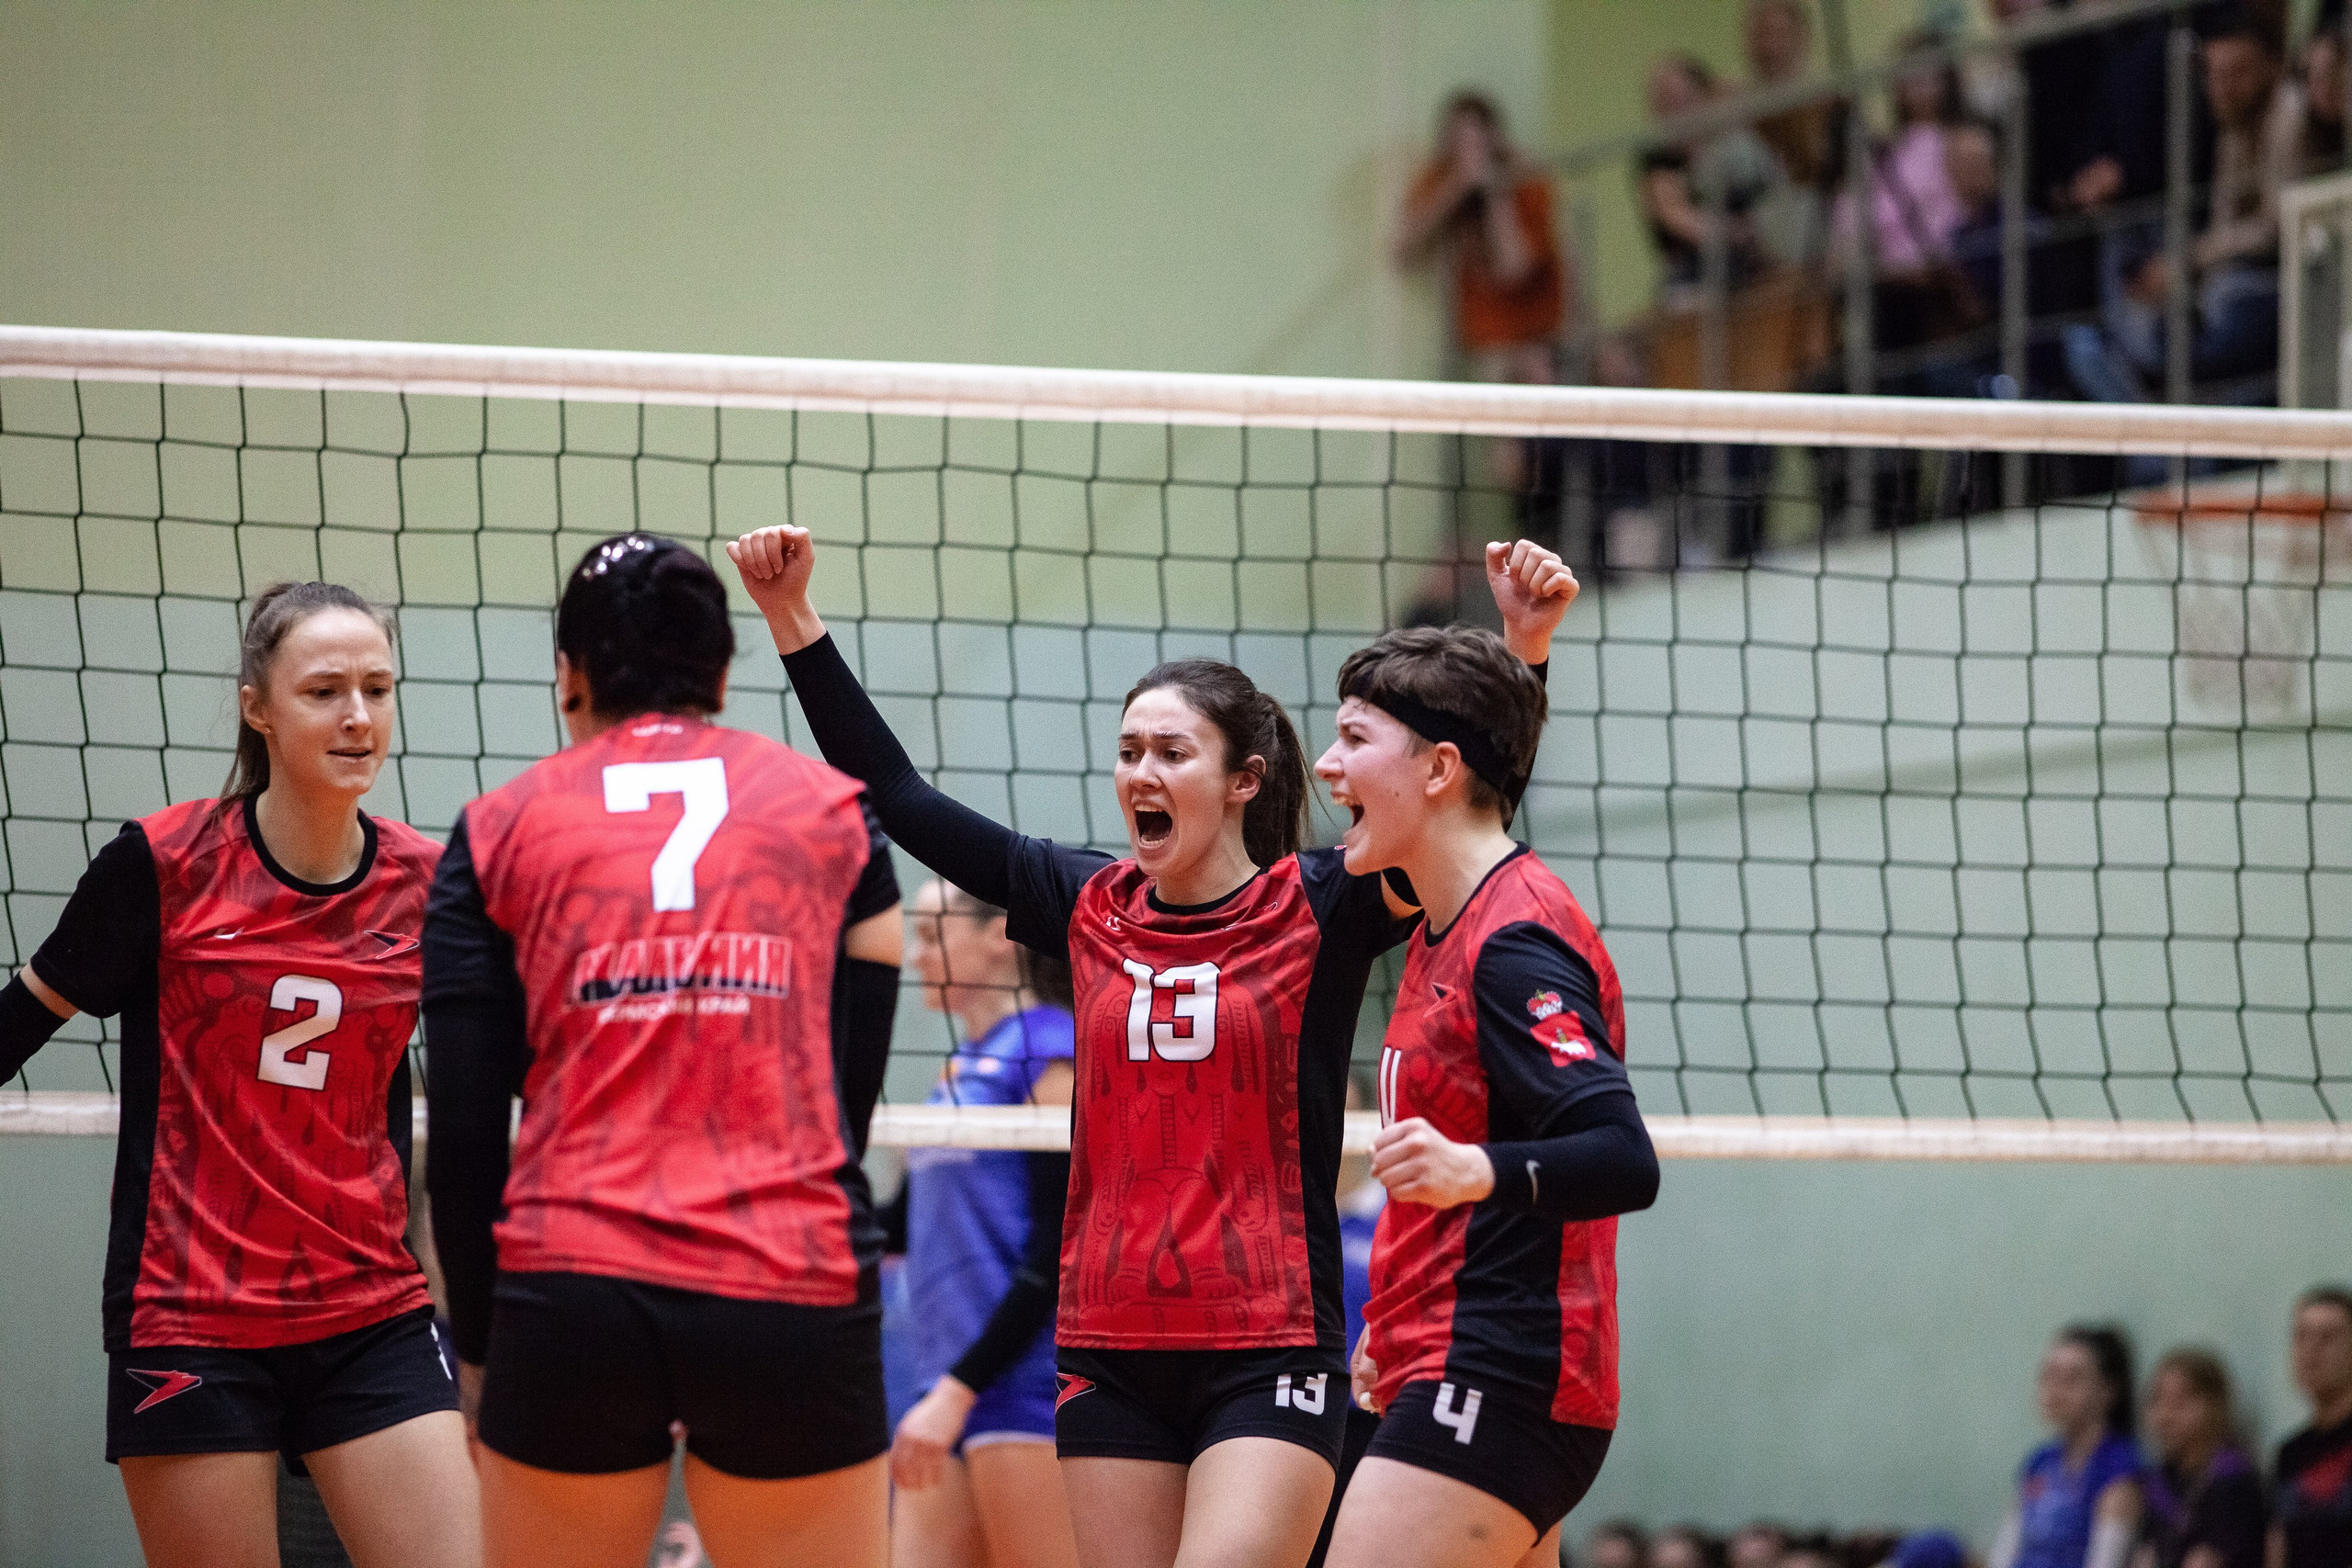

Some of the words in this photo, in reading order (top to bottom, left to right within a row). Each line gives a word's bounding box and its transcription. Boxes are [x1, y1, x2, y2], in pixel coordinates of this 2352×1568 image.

[603, 757, 729, 912] 7
[257, 974, 343, 1090] 2
[1123, 958, 1220, 1061] 13
[1275, 1373, 1327, 1416] 13
[1432, 1382, 1482, 1444] 4
